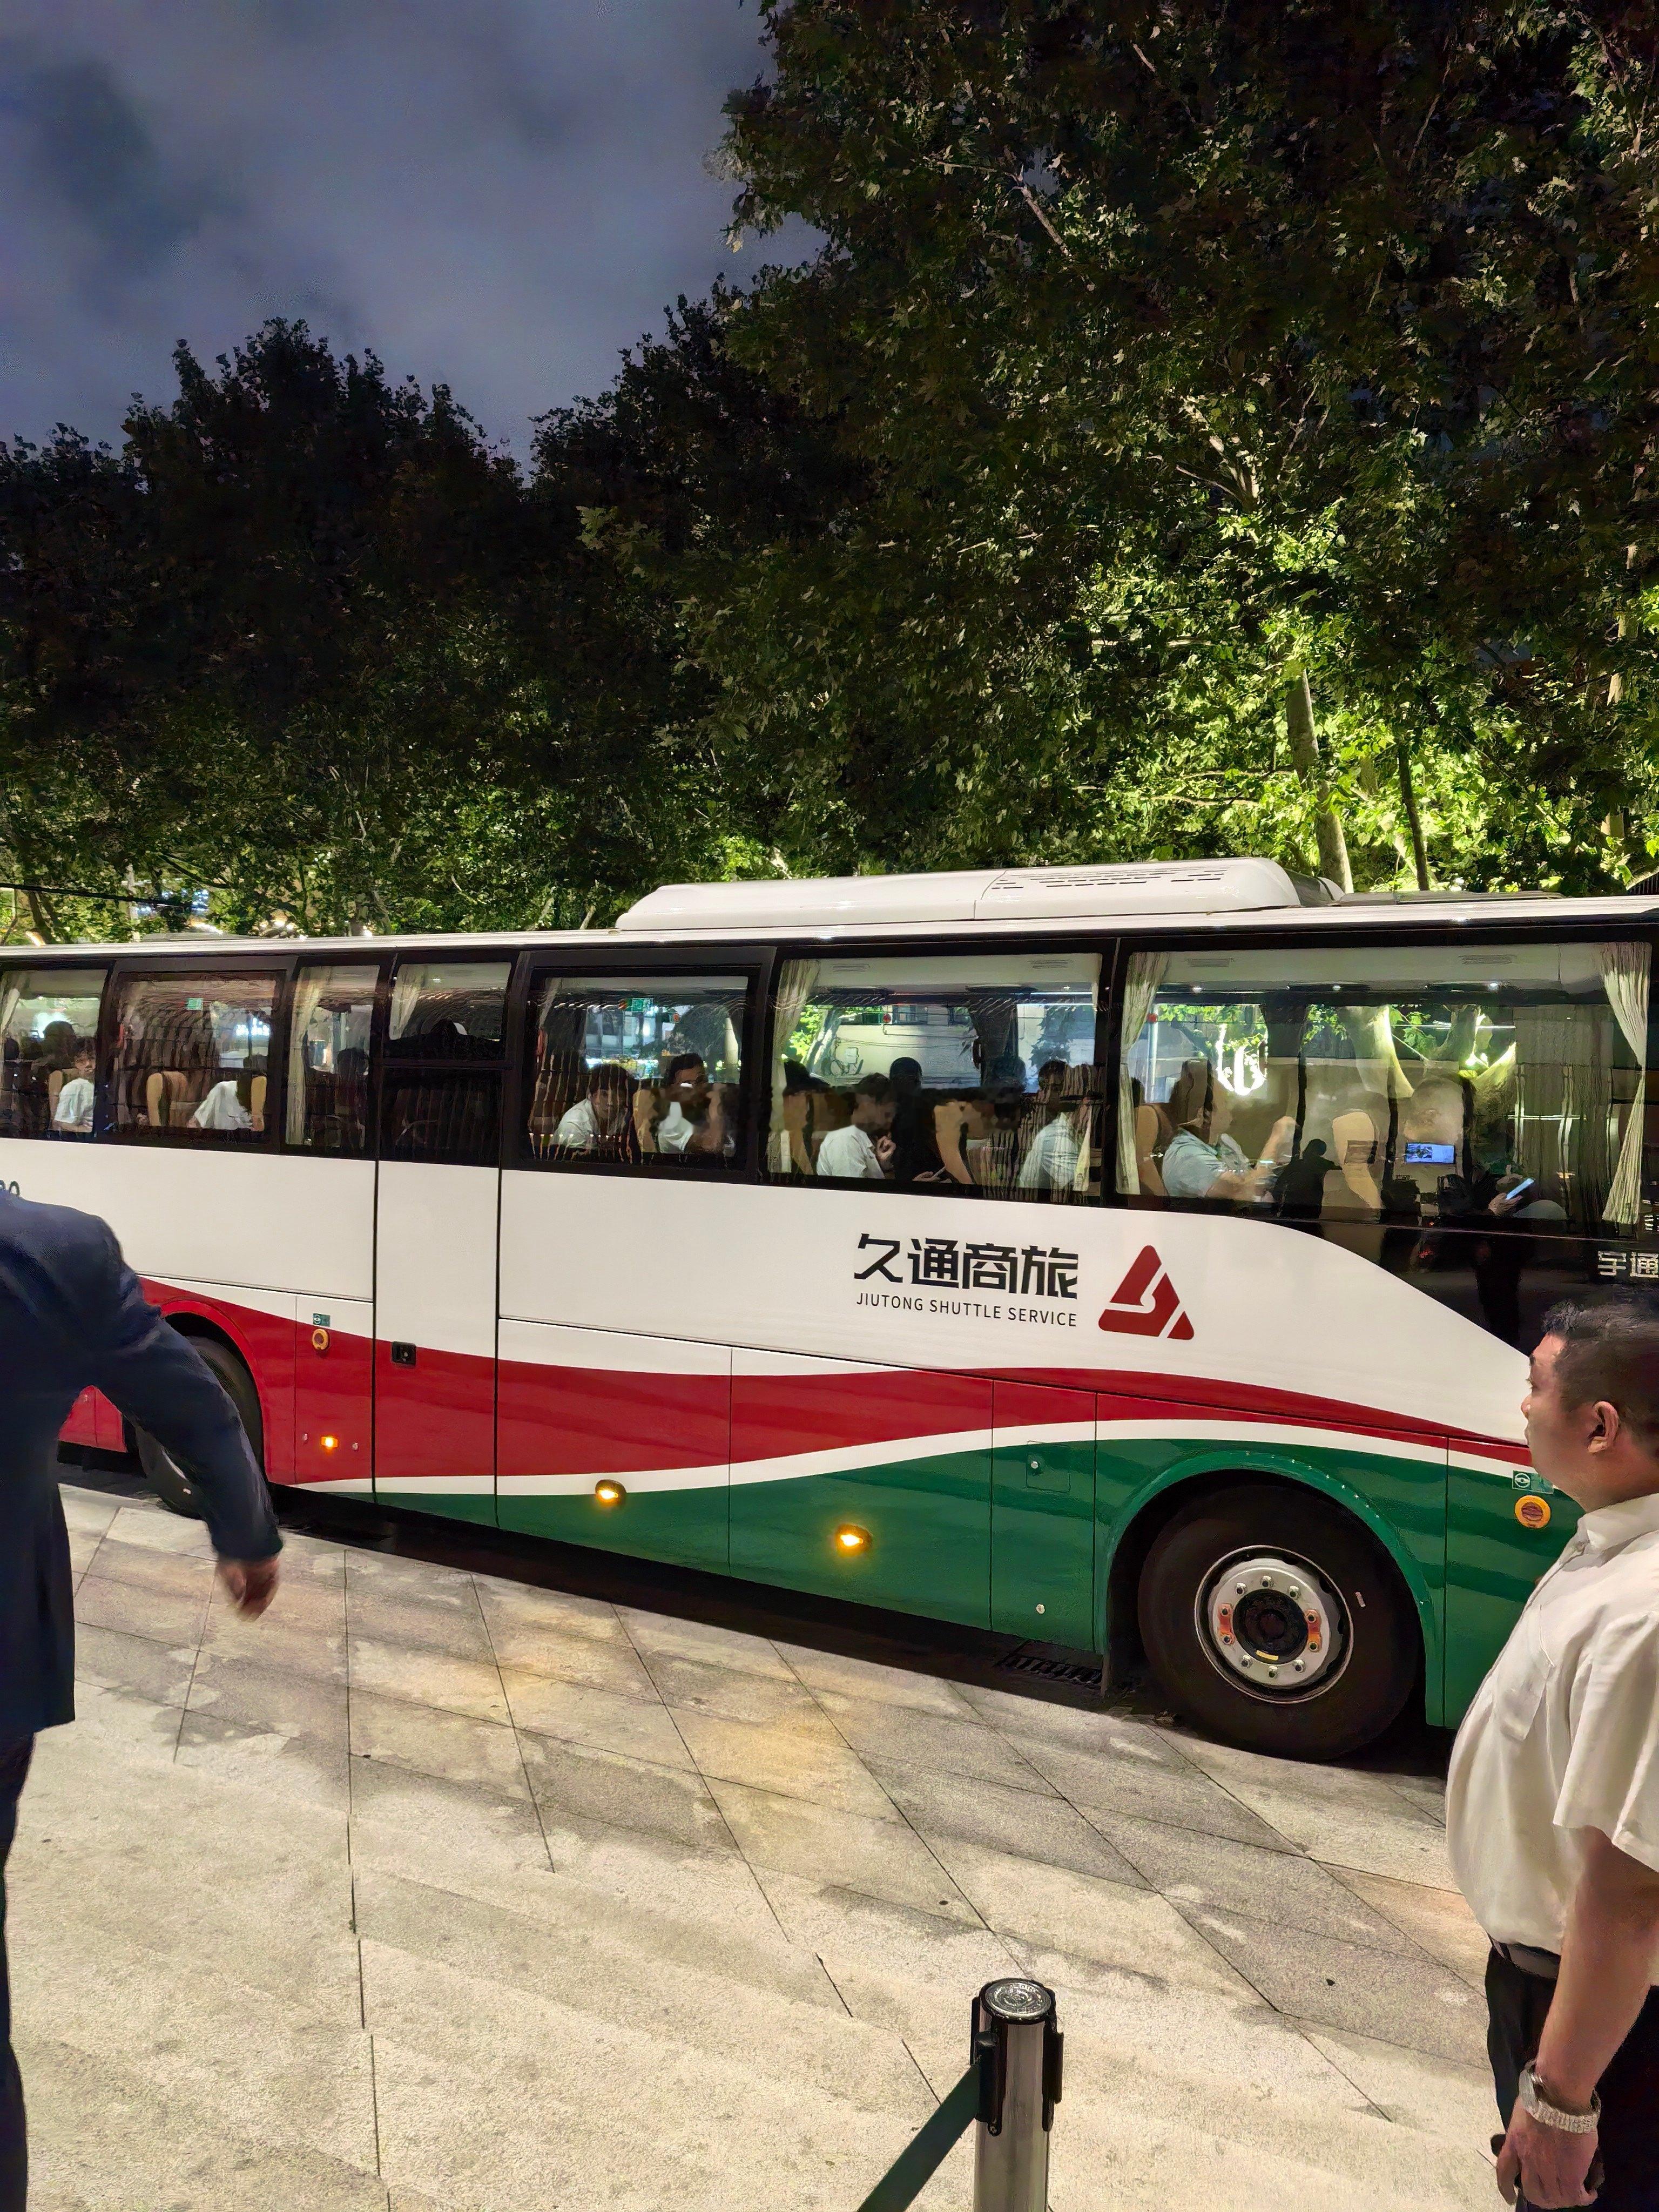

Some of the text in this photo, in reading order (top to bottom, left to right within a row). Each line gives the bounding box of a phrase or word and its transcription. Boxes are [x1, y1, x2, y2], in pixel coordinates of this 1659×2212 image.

[854, 1233, 1079, 1300] 久通商旅
[1597, 1251, 1659, 1278] 宇通
[857, 1293, 1077, 1327] JIUTONG SHUTTLE SERVICE
